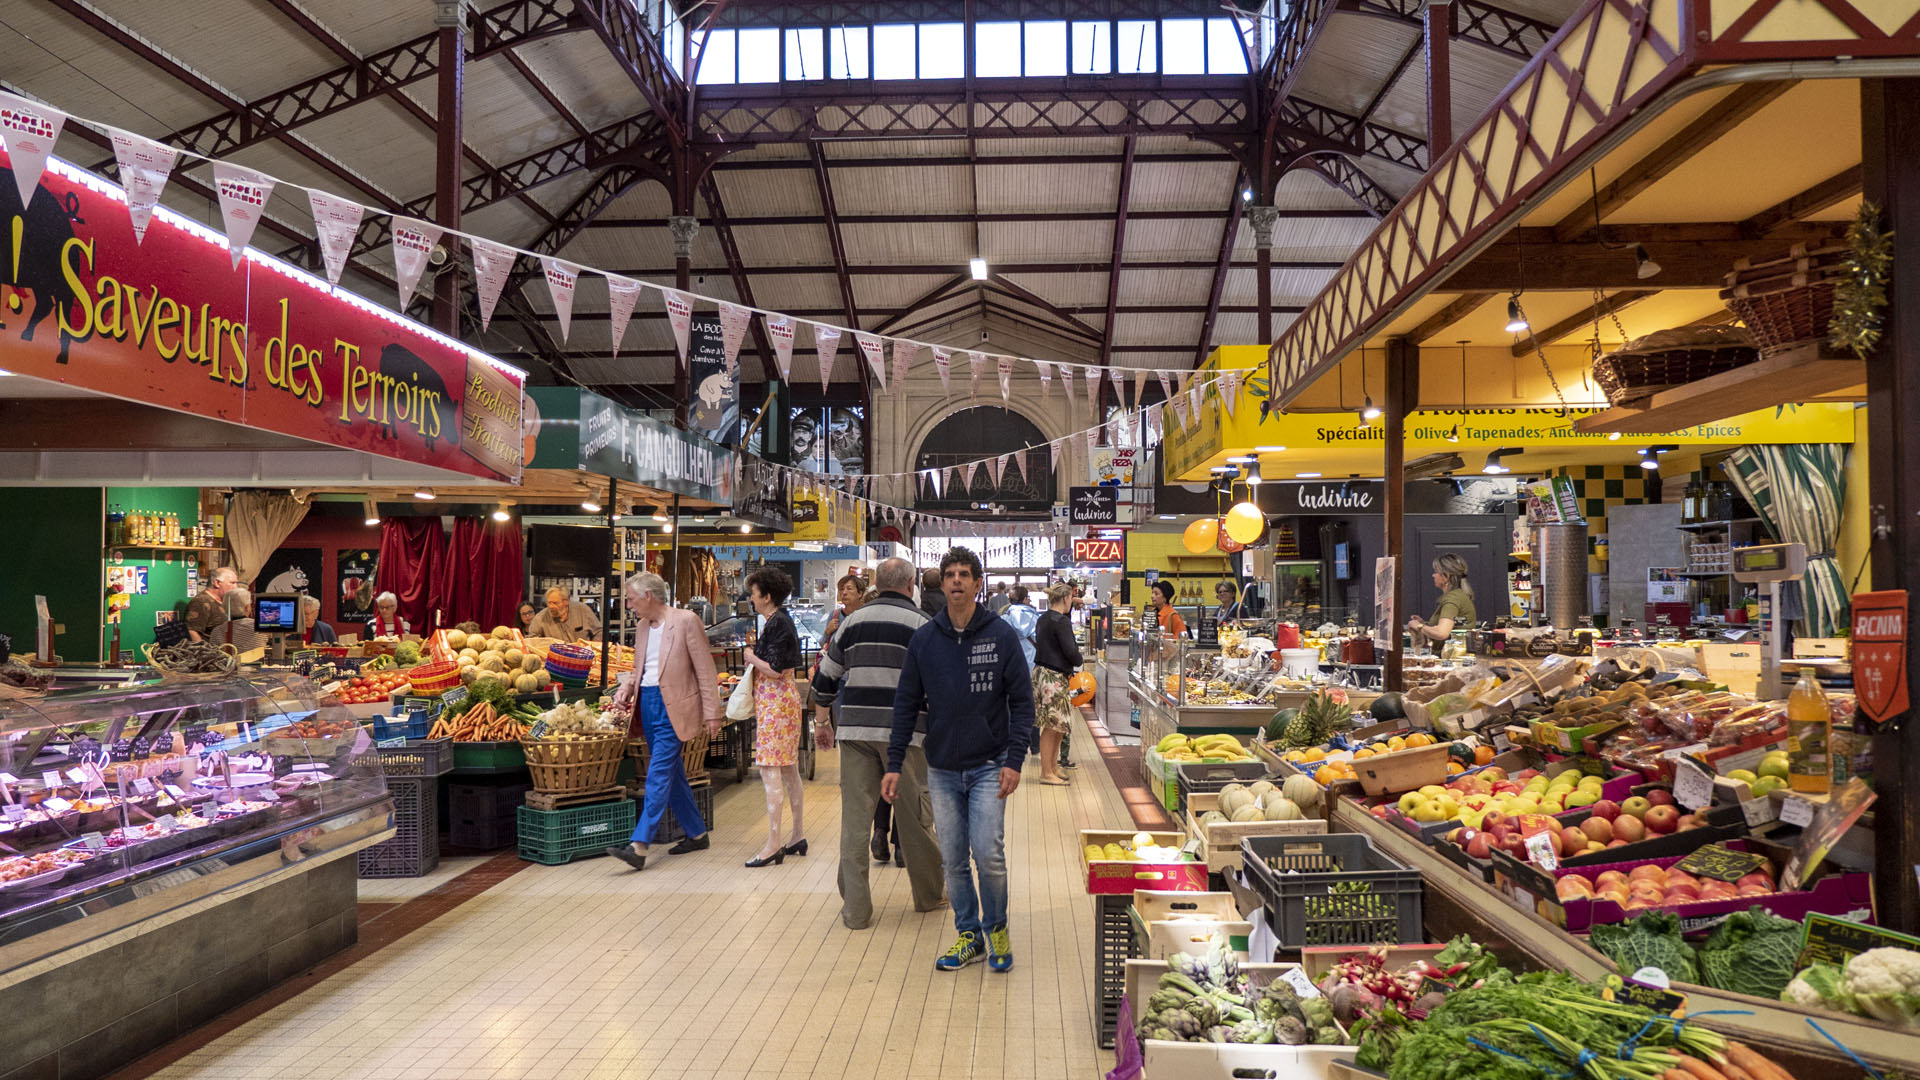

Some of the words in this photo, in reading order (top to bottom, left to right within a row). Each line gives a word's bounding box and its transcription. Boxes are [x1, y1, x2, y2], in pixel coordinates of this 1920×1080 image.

[58, 237, 248, 384] Saveurs
[264, 297, 323, 407] des
[334, 337, 441, 438] Terroirs
[692, 322, 703, 332] LA
[469, 372, 520, 431] Produits
[588, 407, 612, 433] FRUITS
[470, 413, 520, 465] Traiteur
[1316, 426, 1386, 443] Spécialit
[1466, 426, 1544, 441] Tapenades,
[1697, 423, 1742, 439] Epices
[585, 426, 617, 460] PRIMEURS
[621, 417, 632, 464] F.
[635, 423, 713, 487] CANGUILHEM
[1075, 541, 1121, 560] PIZZA
[1855, 615, 1902, 636] RCNM
[968, 653, 998, 664] THRILLS
[972, 643, 996, 654] CHEAP
